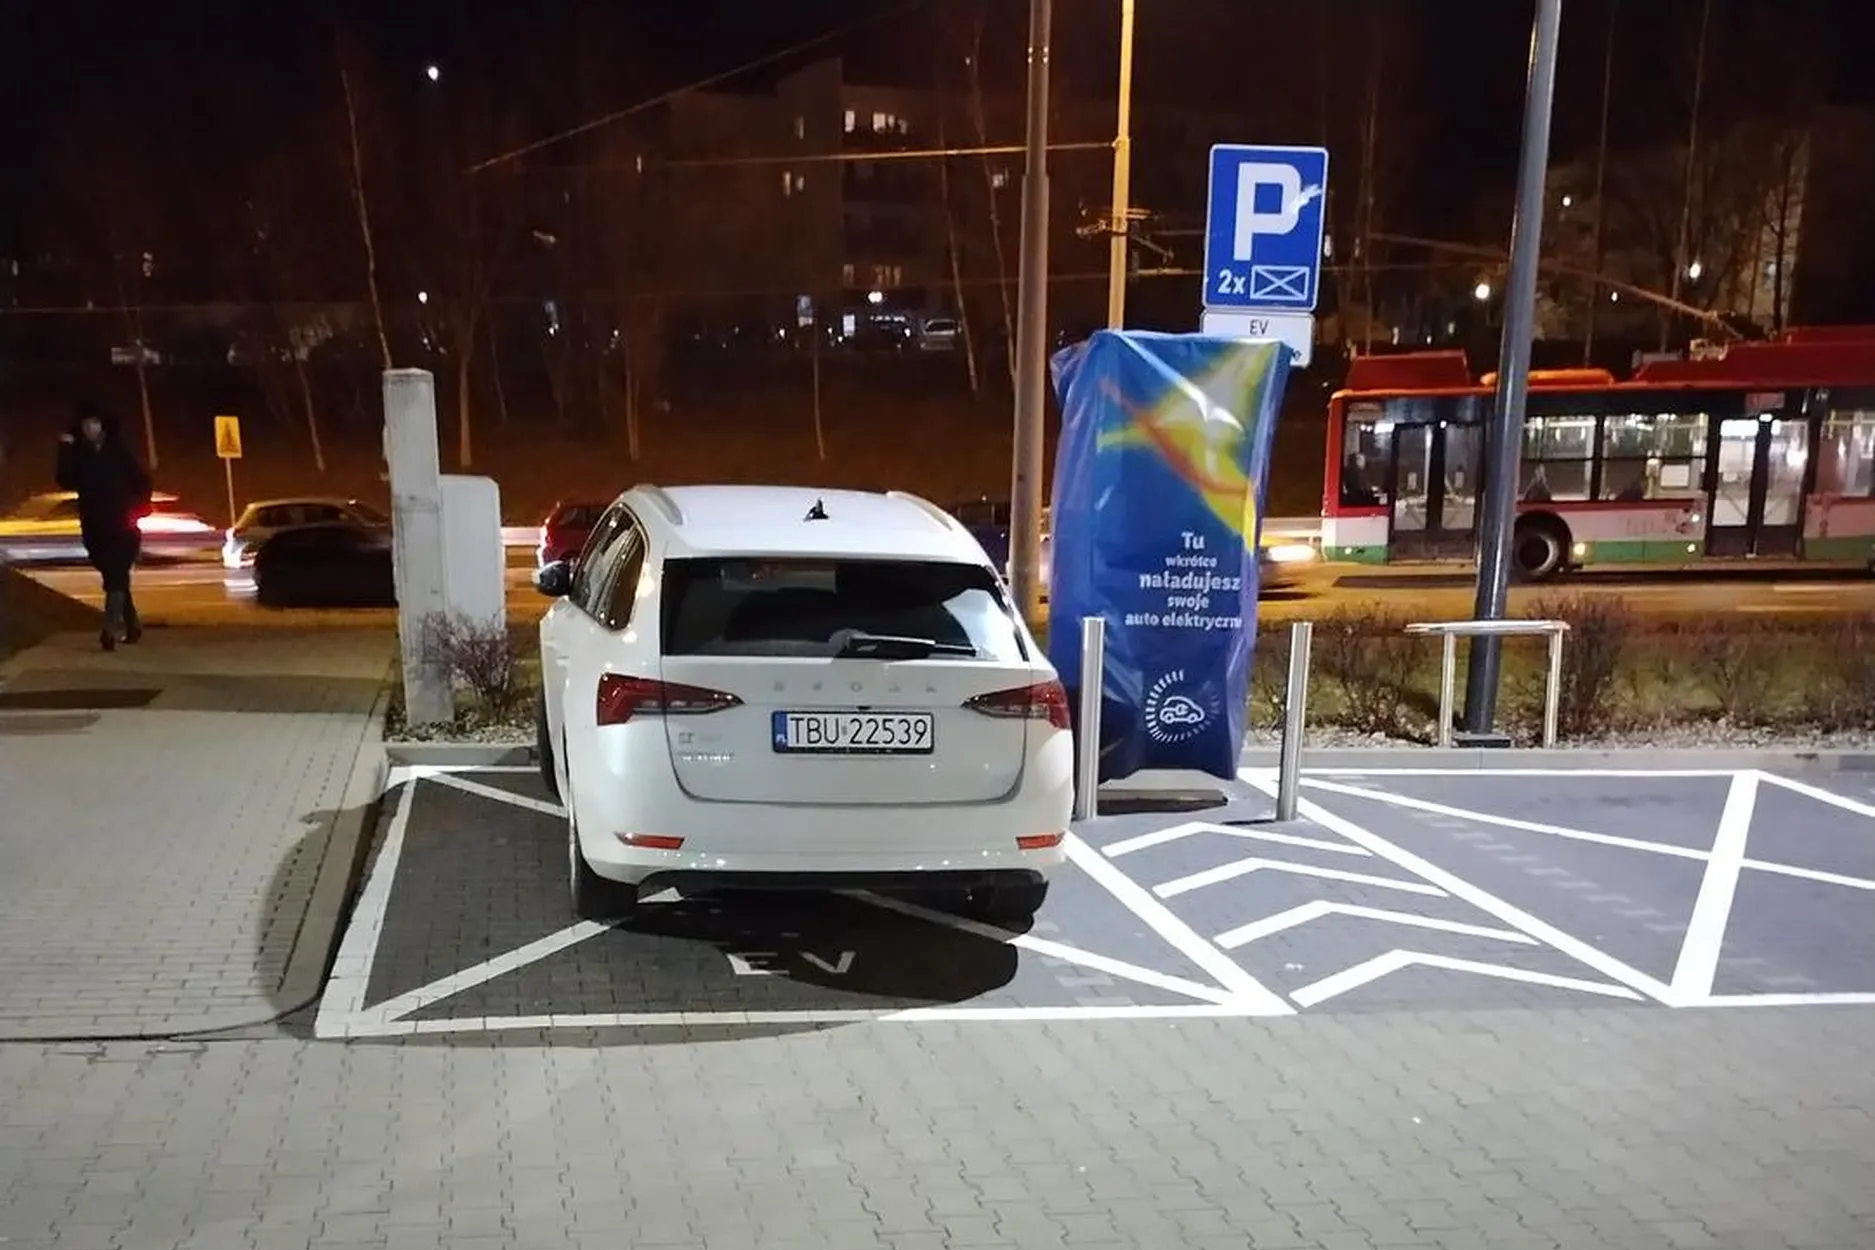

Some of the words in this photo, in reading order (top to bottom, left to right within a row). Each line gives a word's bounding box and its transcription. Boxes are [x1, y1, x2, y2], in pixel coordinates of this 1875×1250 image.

[1233, 161, 1301, 262] P
[1217, 269, 1246, 295] 2x
[1249, 319, 1270, 336] EV
[1181, 531, 1205, 549] Tu
[1165, 555, 1217, 568] wkrótce
[1139, 571, 1241, 593] naładujesz
[1167, 593, 1210, 611] swoje
[1125, 612, 1160, 626] auto
[790, 717, 839, 744] TBU
[850, 718, 928, 745] 22539
[726, 951, 856, 975] EV
